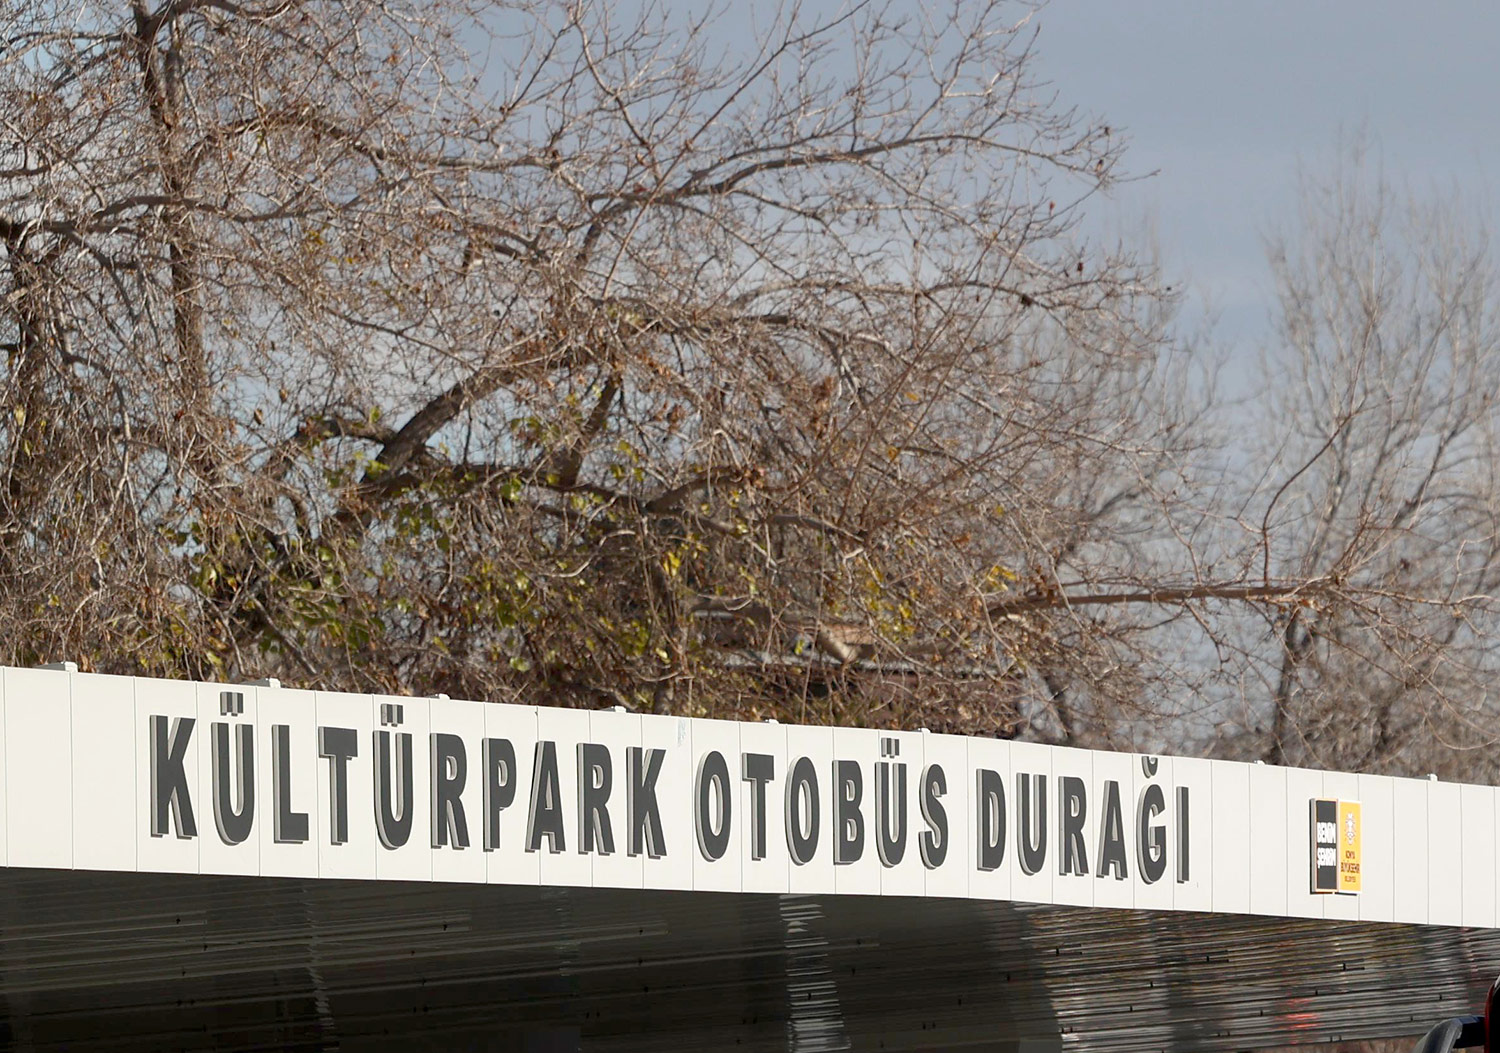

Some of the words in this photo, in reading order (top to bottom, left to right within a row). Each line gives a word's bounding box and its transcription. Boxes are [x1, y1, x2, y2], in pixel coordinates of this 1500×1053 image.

[149, 691, 668, 859] KÜLTÜRPARK
[697, 737, 949, 870] OTOBÜS
[976, 756, 1190, 885] DURAĞI
